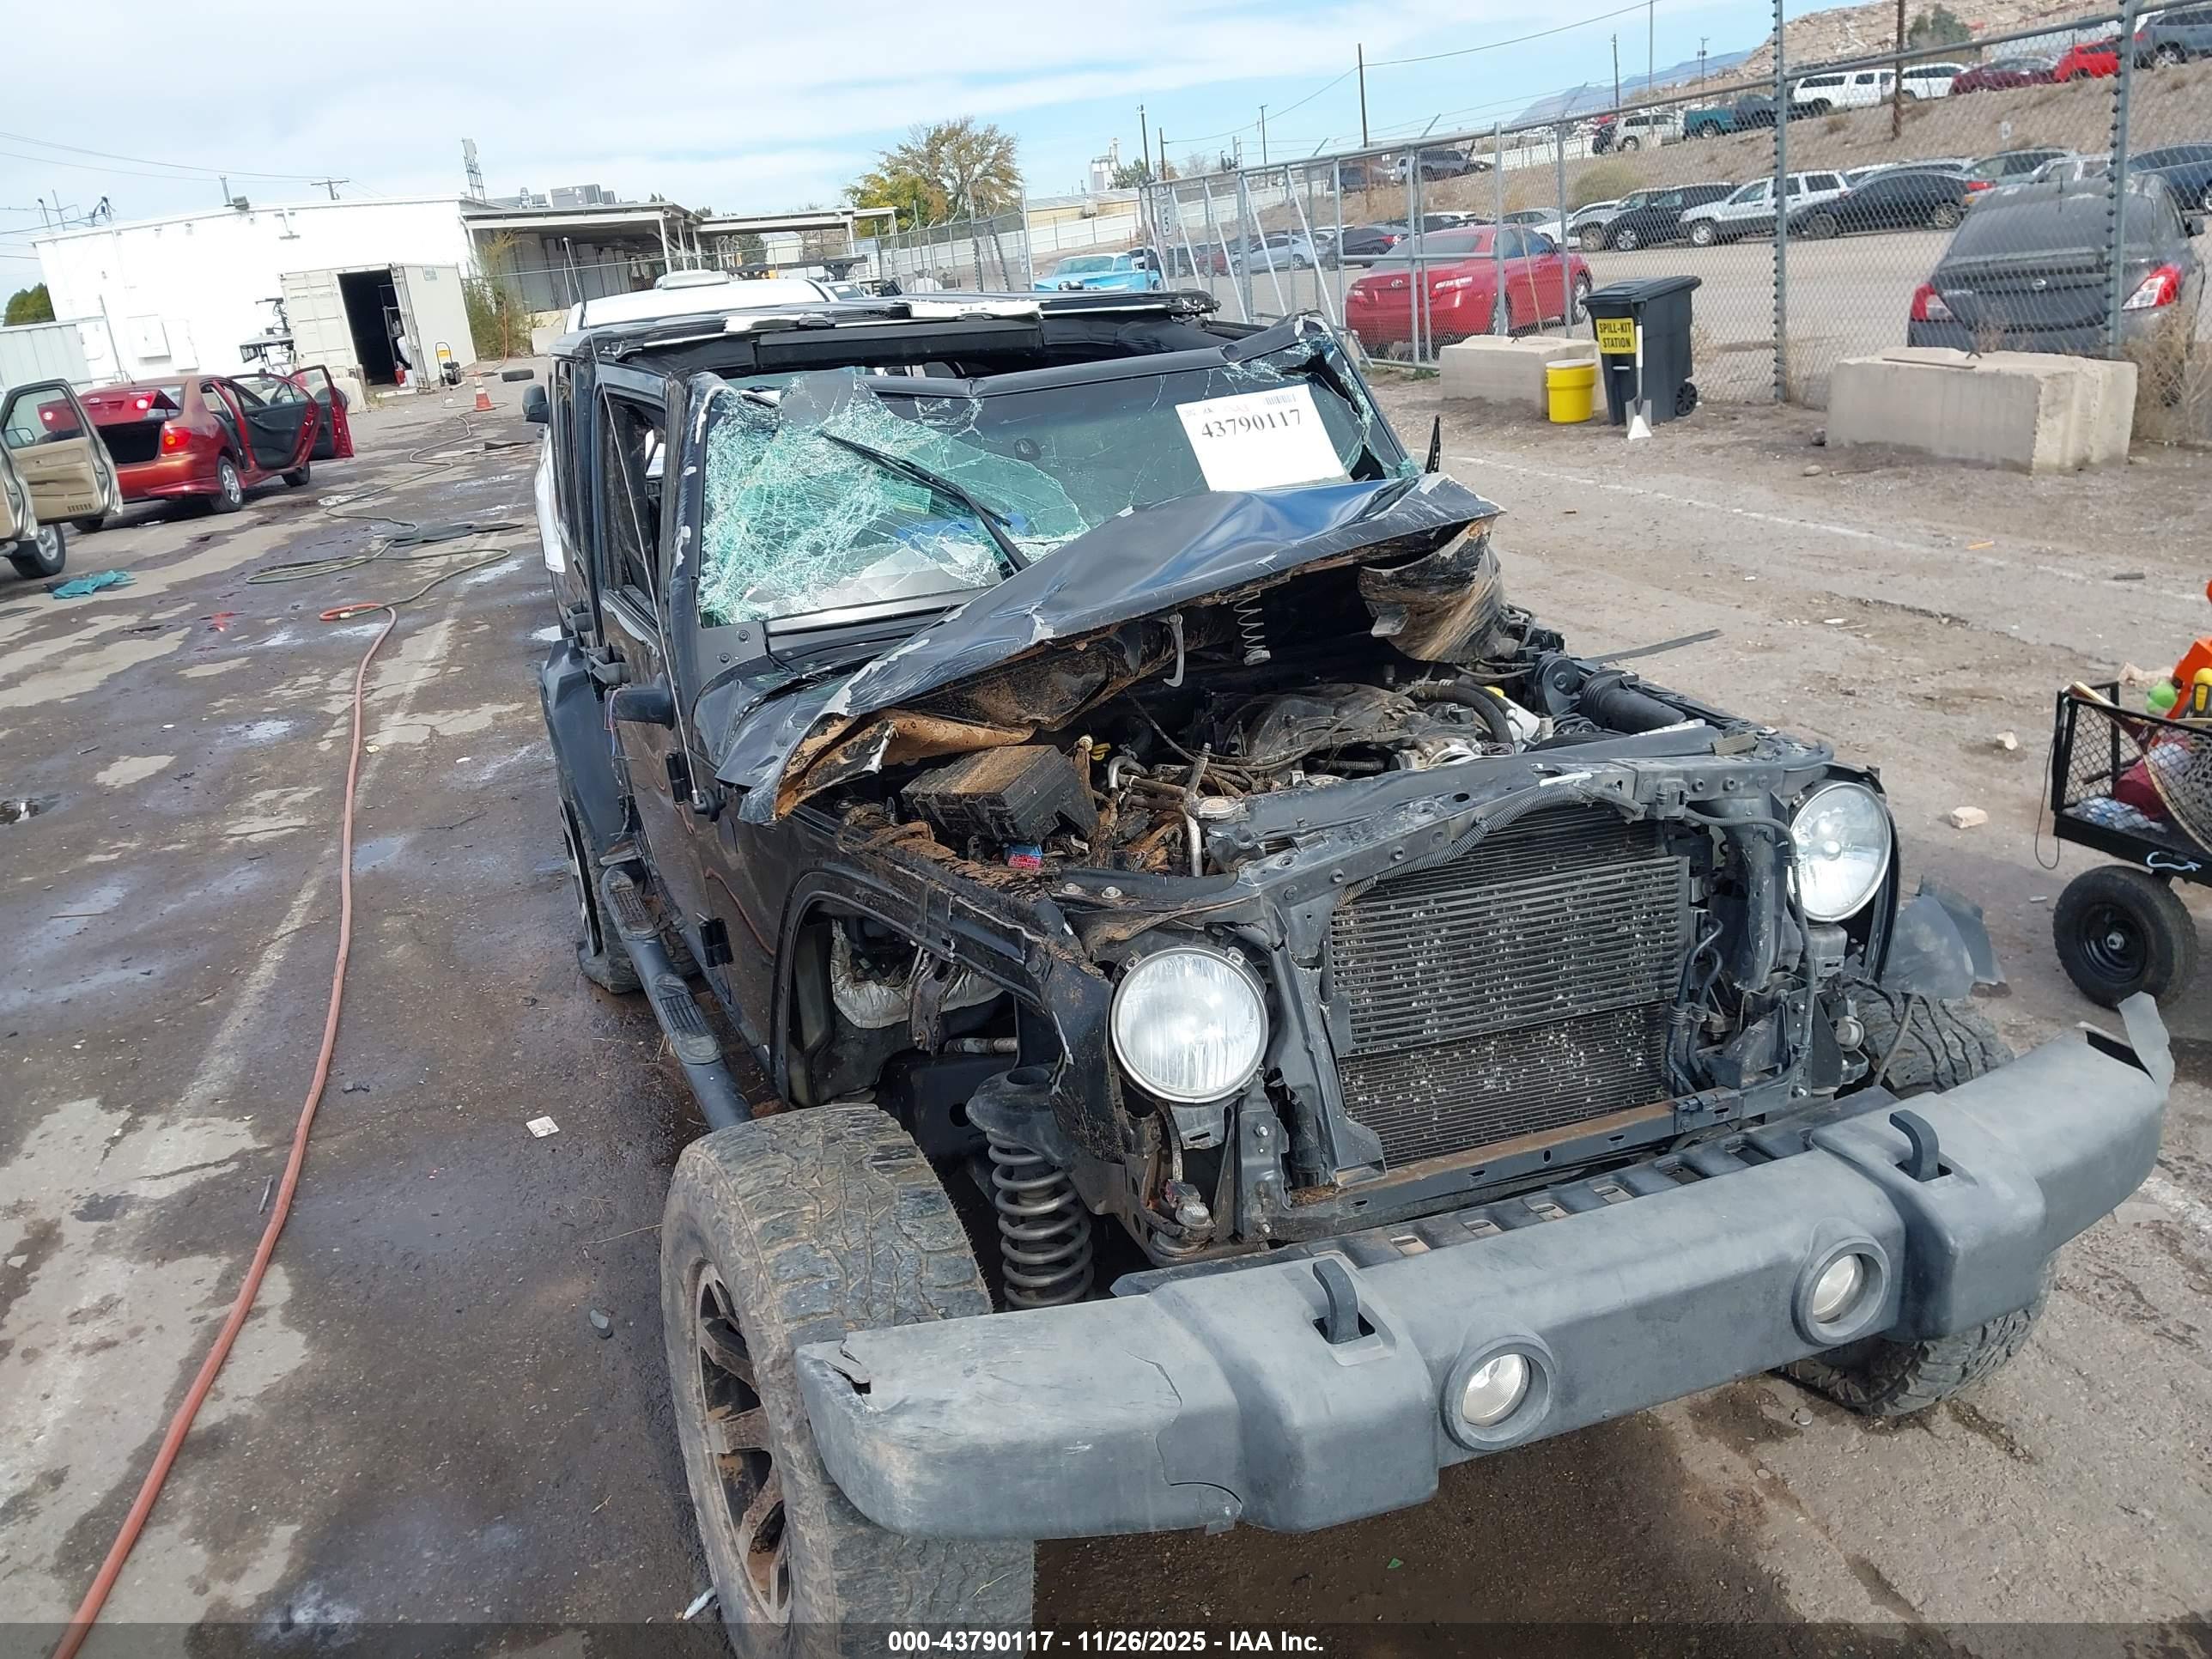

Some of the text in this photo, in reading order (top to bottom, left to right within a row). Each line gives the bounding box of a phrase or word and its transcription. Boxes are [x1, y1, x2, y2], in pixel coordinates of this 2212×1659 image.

[1598, 322, 1632, 333] SPILL-KIT
[1602, 337, 1631, 348] STATION
[1201, 409, 1301, 438] 43790117
